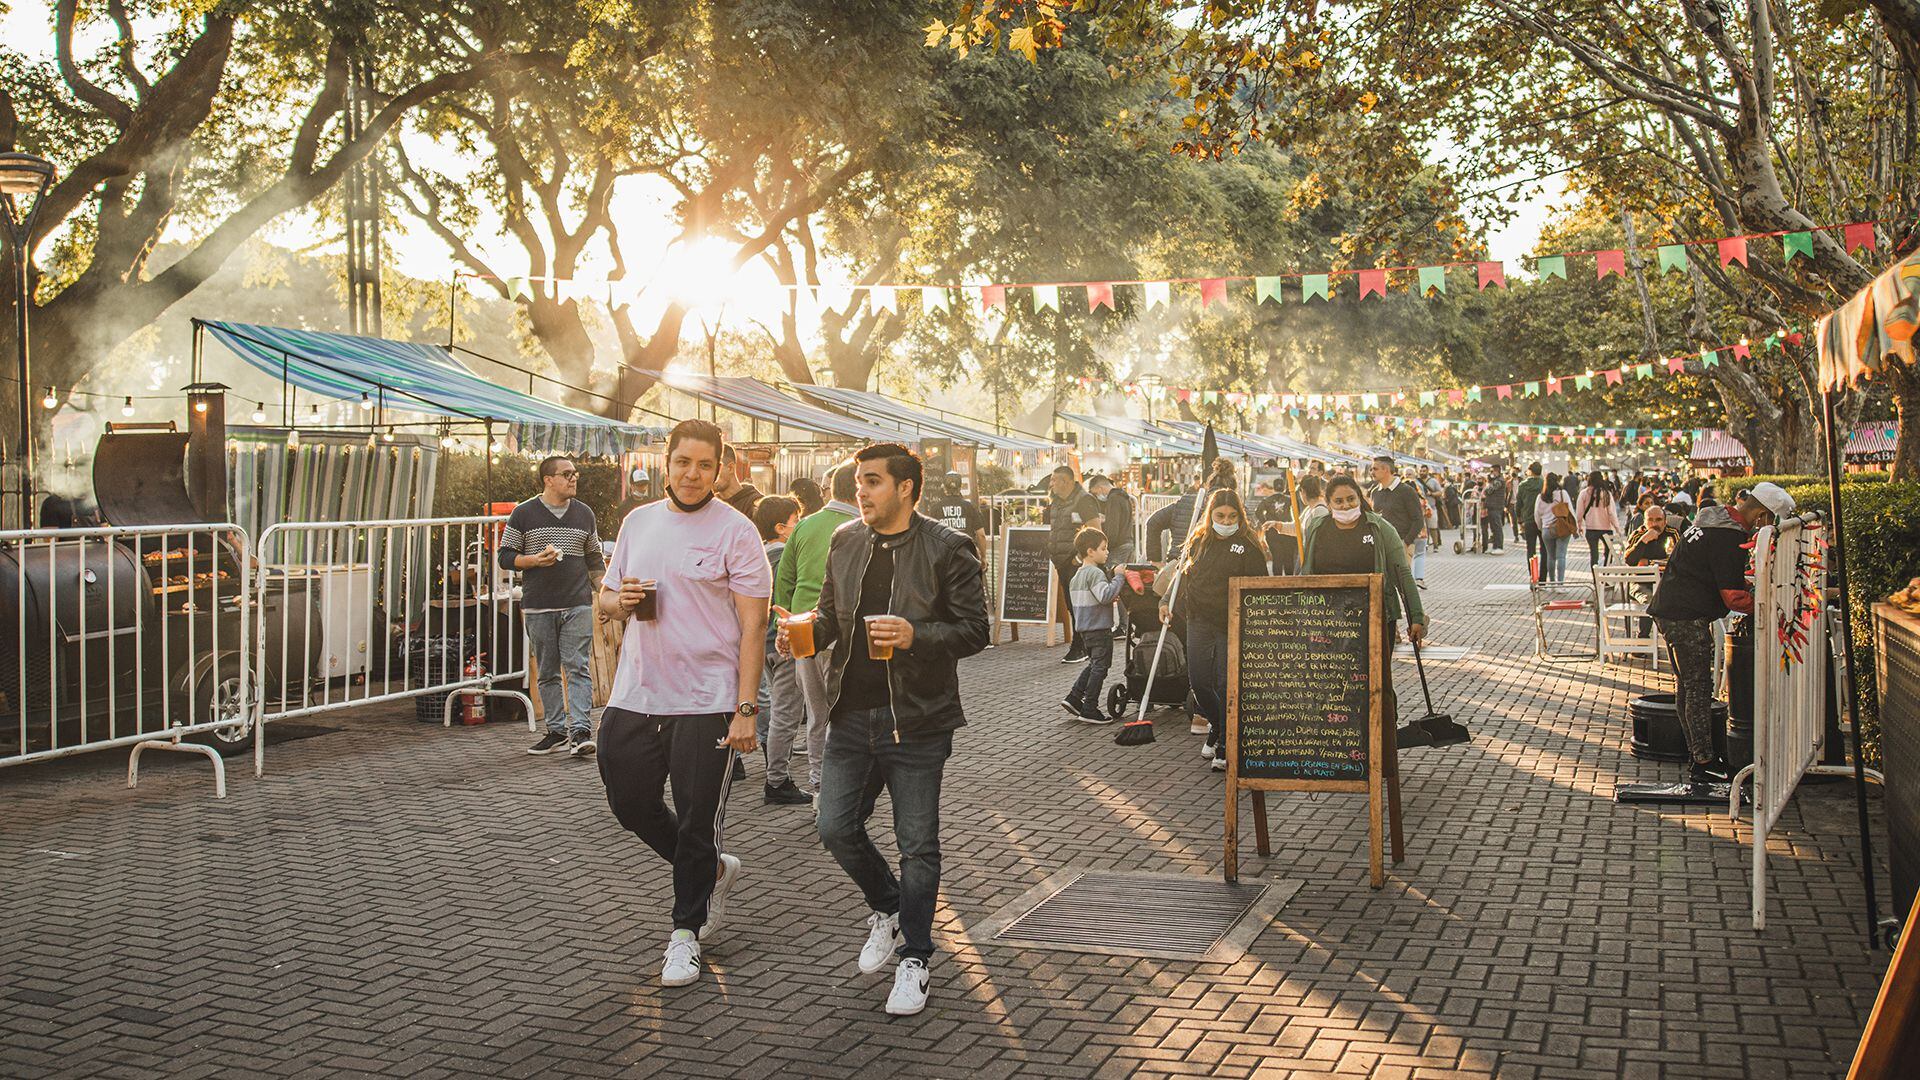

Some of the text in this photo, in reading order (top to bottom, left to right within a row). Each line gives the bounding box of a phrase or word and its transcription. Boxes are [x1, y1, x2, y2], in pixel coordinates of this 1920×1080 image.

[942, 505, 962, 517] VIEJO
[1244, 594, 1292, 606] CAMPESTRE
[1246, 608, 1265, 618] BIFE
[1313, 768, 1335, 777] PLATO
